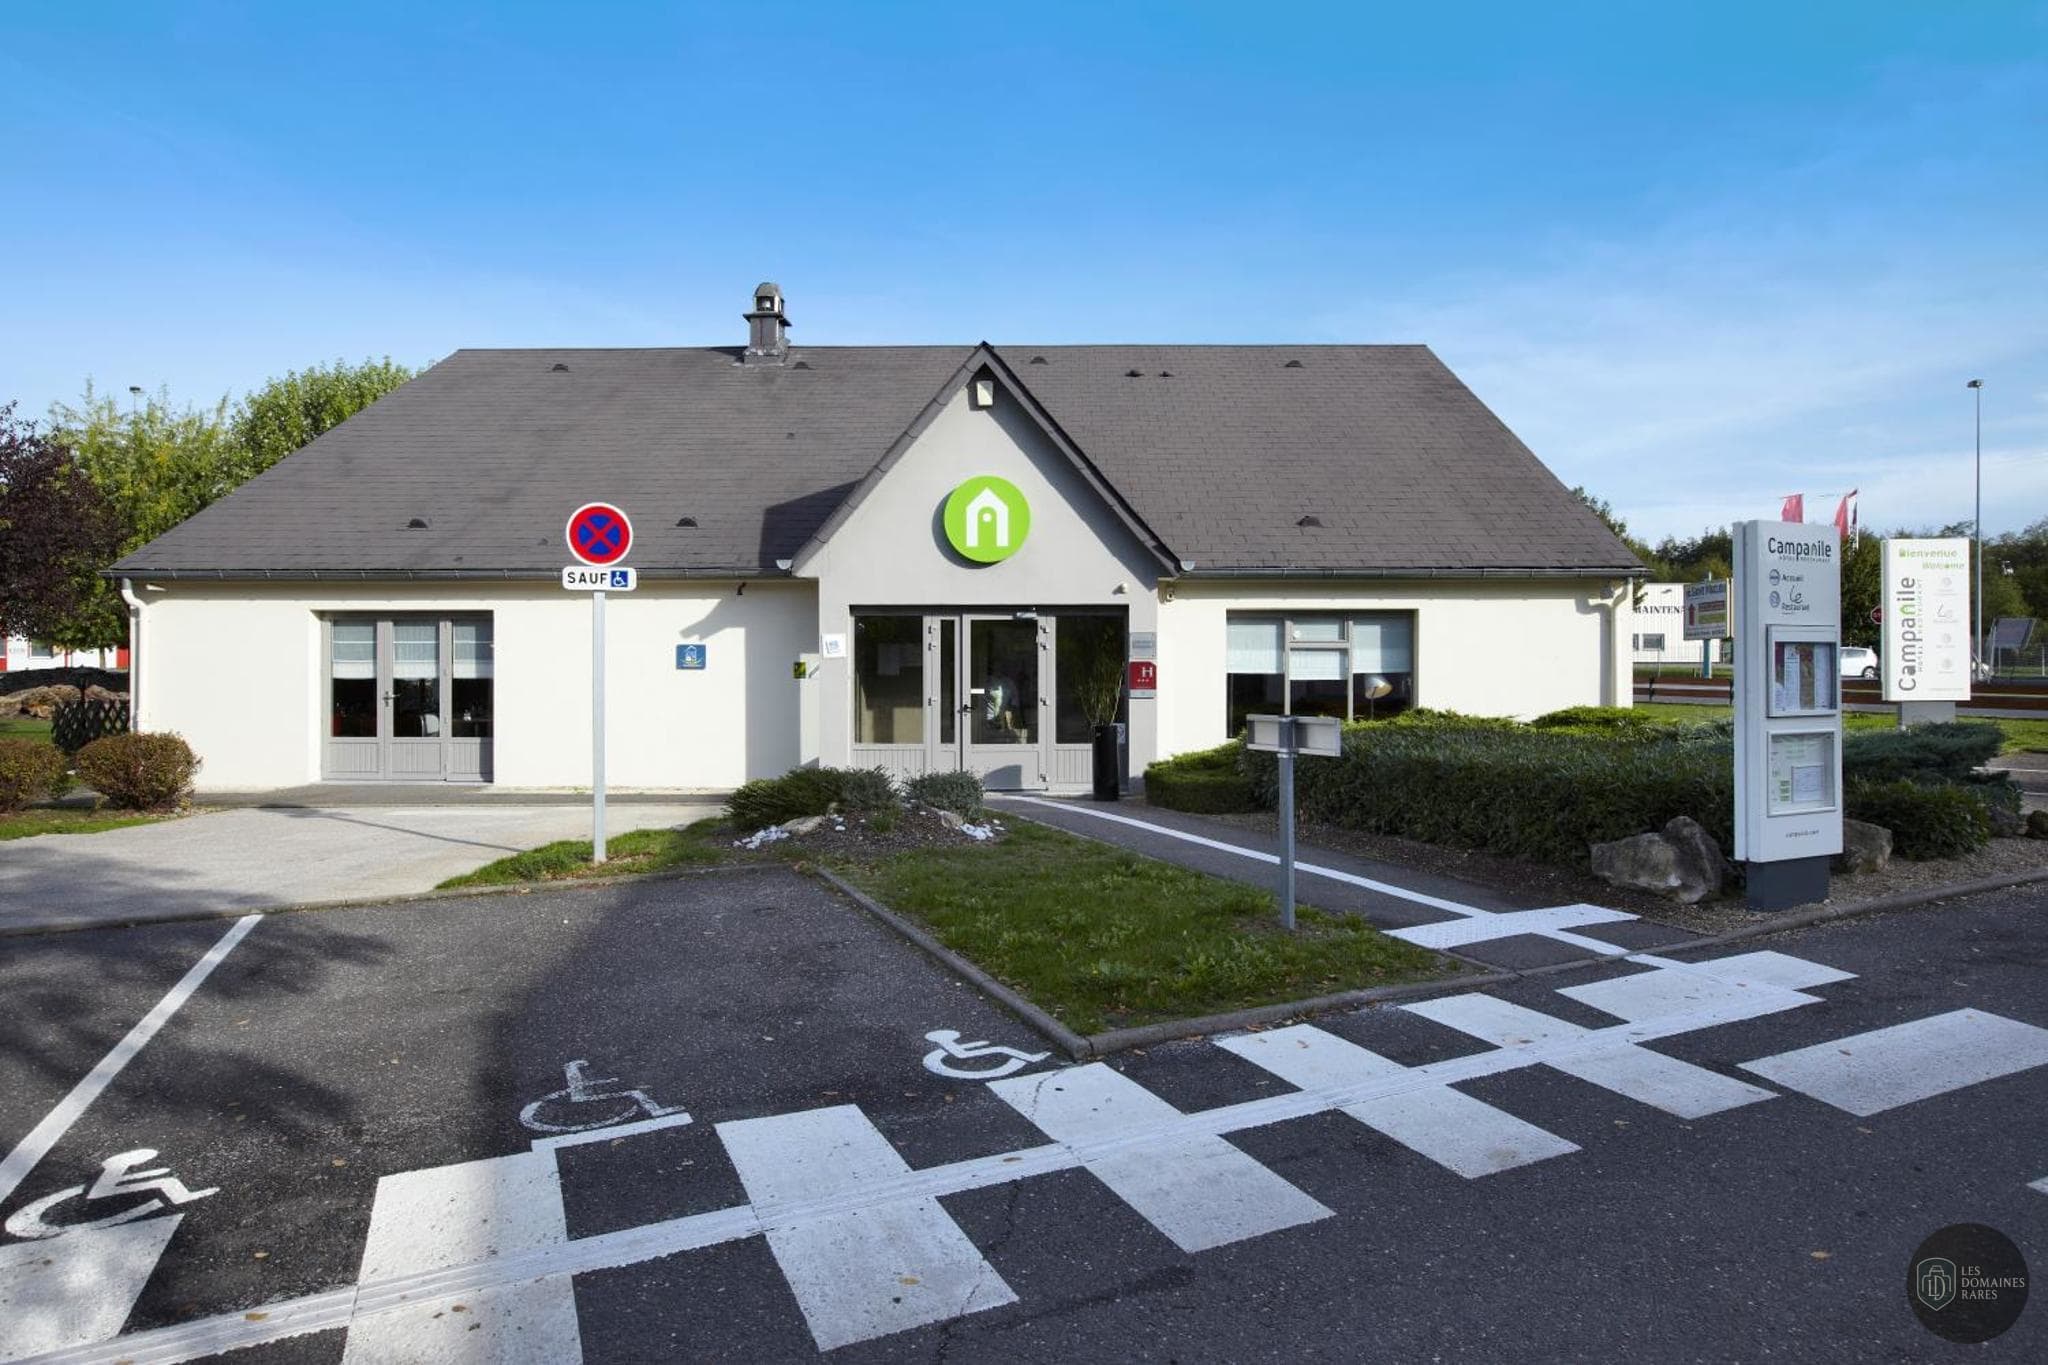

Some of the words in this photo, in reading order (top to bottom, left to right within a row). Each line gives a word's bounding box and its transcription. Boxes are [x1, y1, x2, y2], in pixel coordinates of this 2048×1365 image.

[1767, 537, 1832, 562] Campanile
[567, 571, 608, 585] SAUF
[1896, 577, 1923, 692] Campanile
[1142, 666, 1153, 678] H
